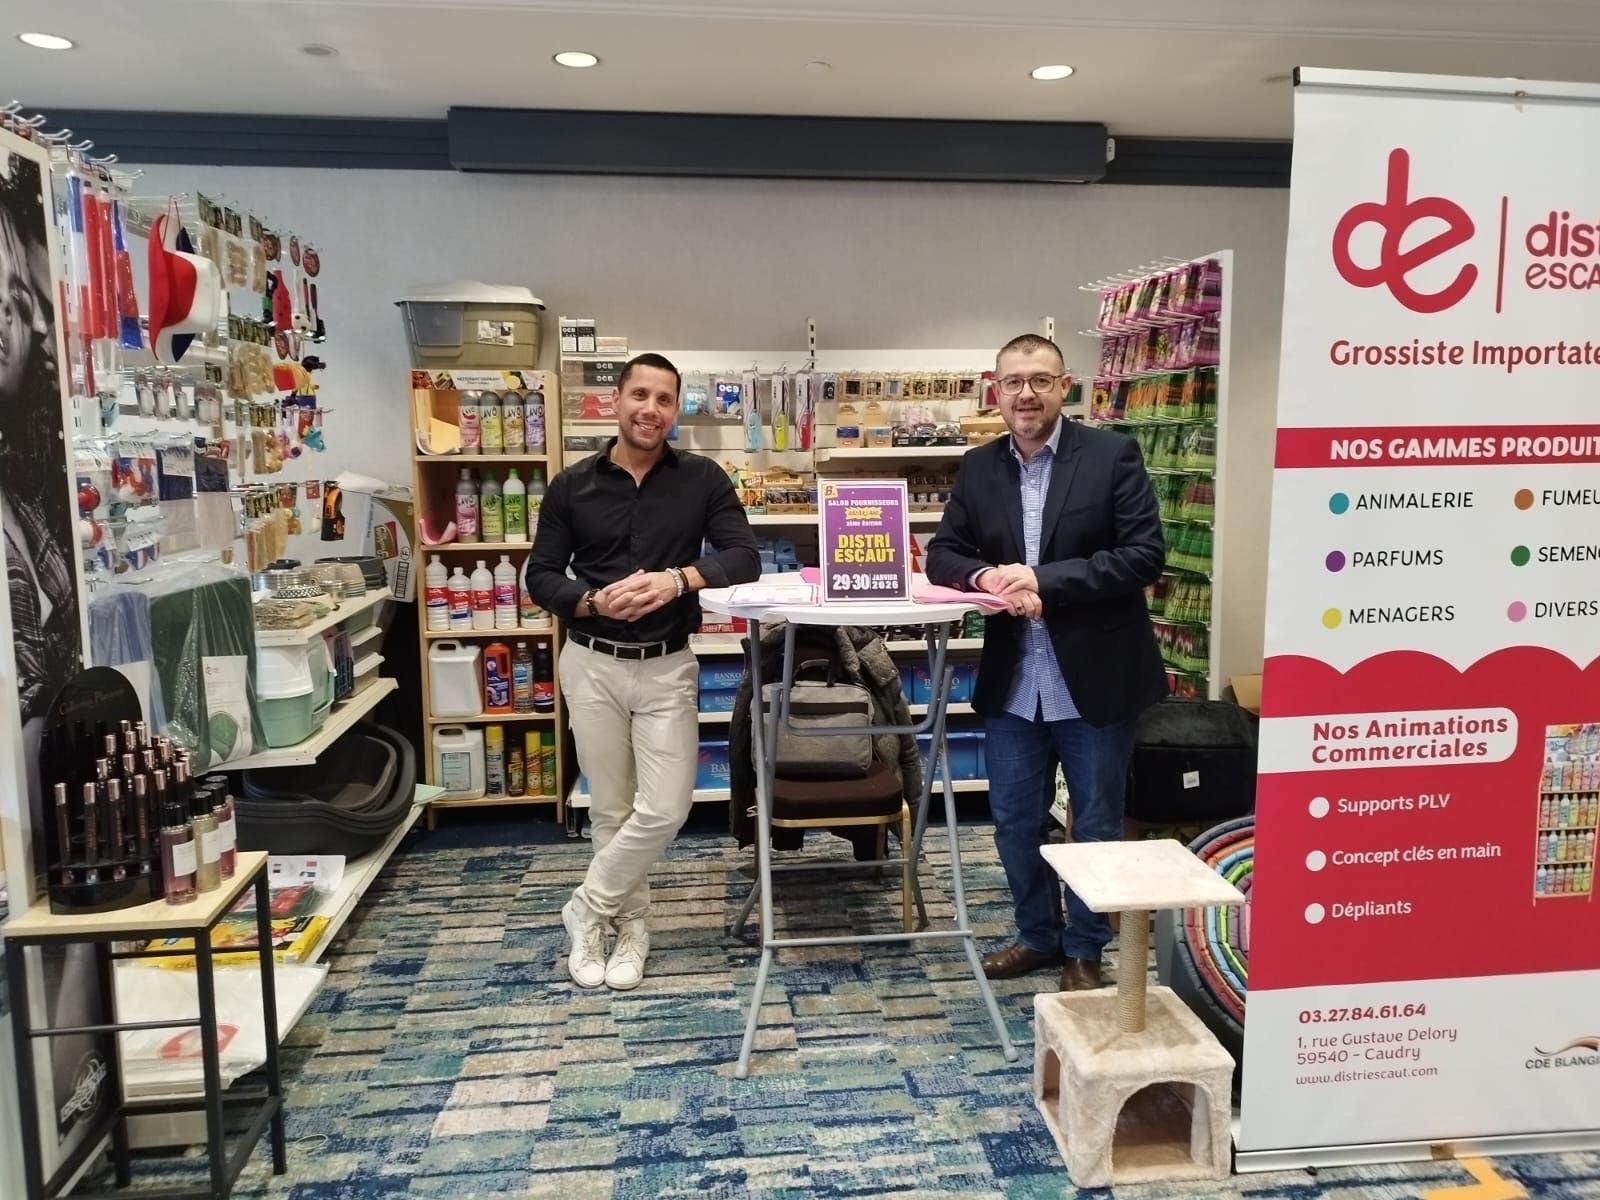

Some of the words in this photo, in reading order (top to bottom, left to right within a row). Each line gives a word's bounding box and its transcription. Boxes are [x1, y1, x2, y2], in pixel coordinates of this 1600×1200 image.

[1526, 211, 1600, 258] dis
[1330, 339, 1464, 365] Grossiste
[719, 384, 739, 393] OCB
[1331, 439, 1382, 460] NOS
[1388, 437, 1495, 459] GAMMES
[1355, 491, 1474, 510] ANIMALERIE
[838, 533, 890, 548] DISTRI
[834, 548, 896, 563] ESCAUT
[1352, 550, 1444, 567] PARFUMS
[1538, 545, 1600, 562] SEMEN
[872, 581, 899, 590] 2026
[1349, 605, 1455, 624] MENAGERS
[1534, 600, 1598, 618] DIVERS
[1313, 723, 1359, 740] Nos
[1366, 716, 1508, 739] Animations
[1312, 740, 1487, 763] Commerciales
[1337, 796, 1414, 816] Supports
[1418, 793, 1450, 810] PLV
[1331, 849, 1400, 868] Concept
[1403, 845, 1434, 862] clés
[1439, 849, 1457, 861] en
[1461, 843, 1501, 859] main
[1331, 901, 1411, 920] Dépliants
[1298, 1004, 1426, 1025] 03.27.84.61.64
[1297, 1036, 1307, 1050] 1,
[1312, 1036, 1338, 1048] rue
[1342, 1029, 1403, 1047] Gustave
[1407, 1025, 1457, 1043] Delory
[1297, 1050, 1348, 1066] 59540
[1364, 1044, 1421, 1062] Caudry
[1525, 1058, 1551, 1069] CDE
[1296, 1065, 1438, 1086] www.distriescaut.com
